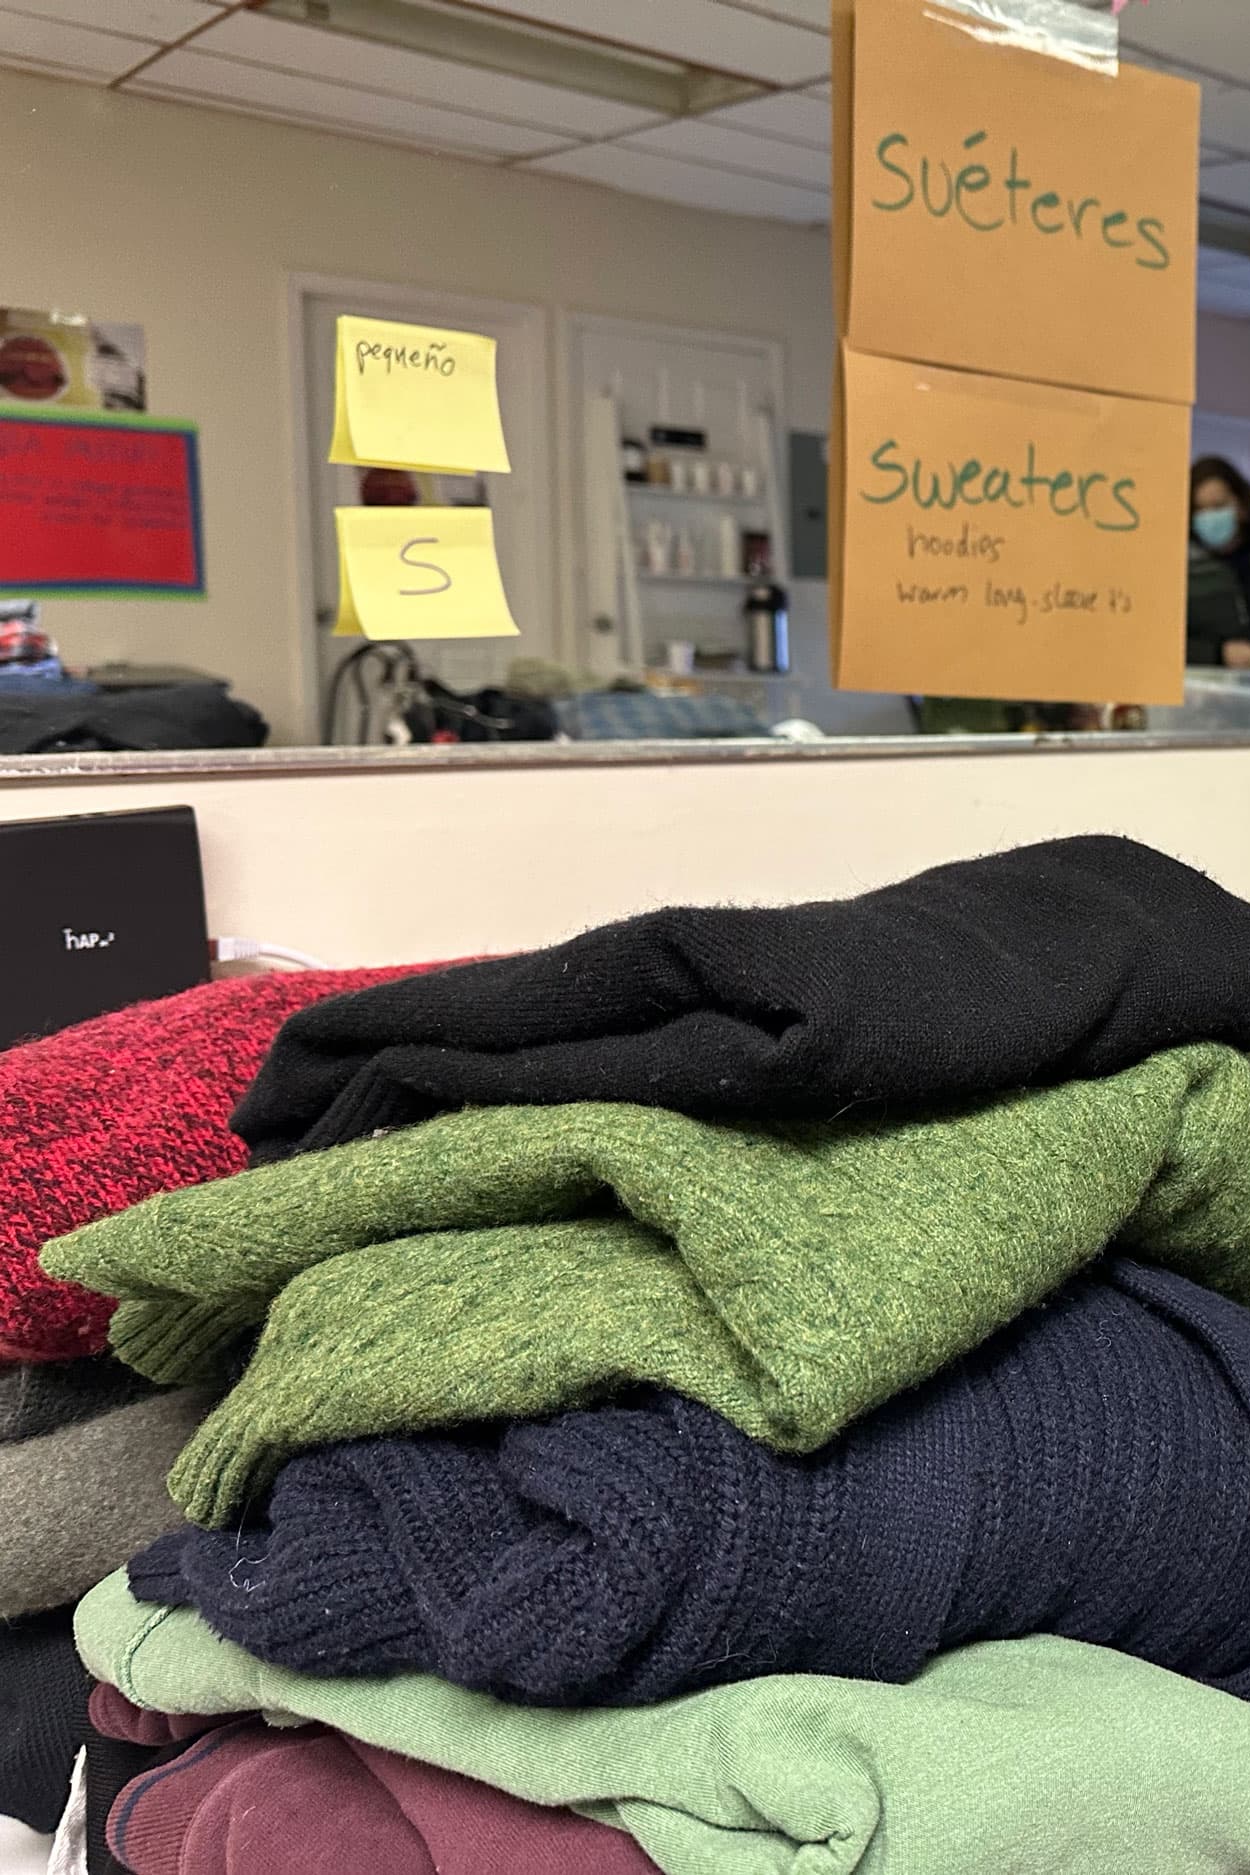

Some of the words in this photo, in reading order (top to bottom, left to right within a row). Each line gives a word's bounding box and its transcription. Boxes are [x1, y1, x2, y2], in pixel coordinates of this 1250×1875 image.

[872, 130, 1171, 270] Suéteres
[356, 339, 456, 377] pequeño
[860, 440, 1140, 532] Sweaters
[397, 537, 452, 596] S
[905, 522, 1006, 563] hoodies
[895, 578, 969, 605] warm
